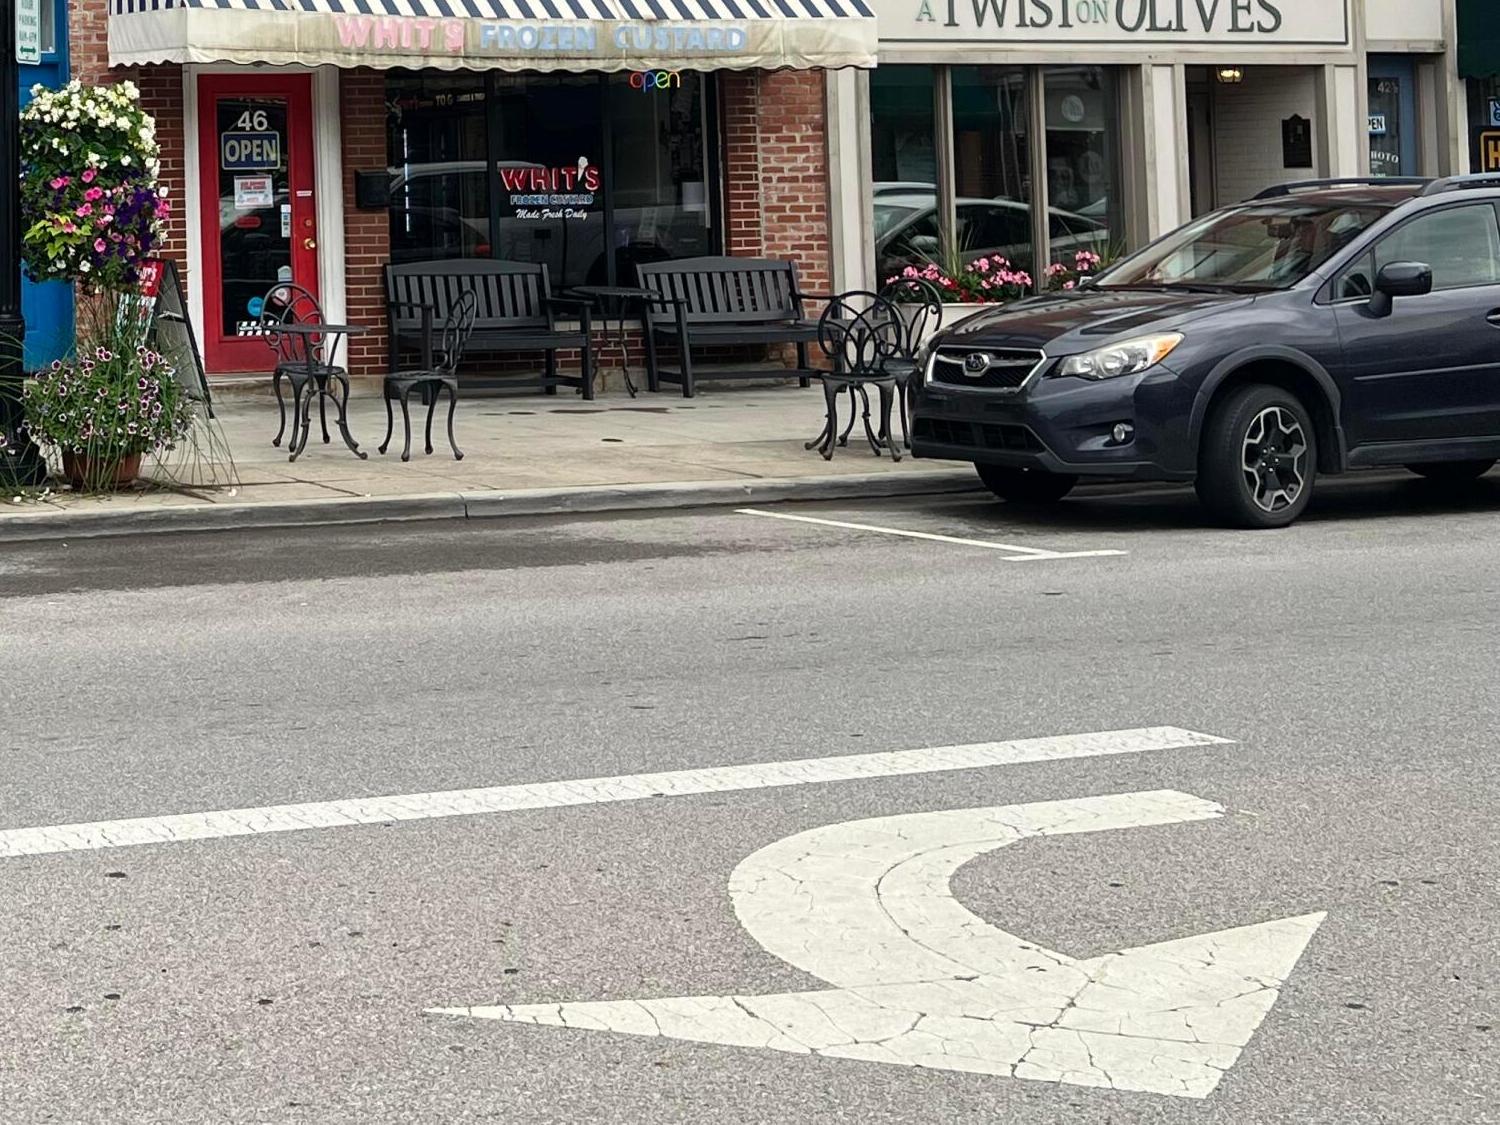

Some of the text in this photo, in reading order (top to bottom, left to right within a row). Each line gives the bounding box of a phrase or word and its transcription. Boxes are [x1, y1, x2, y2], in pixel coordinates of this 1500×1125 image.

[480, 24, 596, 51] FROZEN
[612, 24, 747, 52] CUSTARD
[629, 71, 680, 93] open
[237, 110, 268, 131] 46
[1368, 117, 1383, 130] EN
[225, 139, 277, 162] OPEN
[500, 156, 600, 191] WHIT'S
[510, 194, 549, 206] FROZEN
[516, 208, 588, 220] Made Fresh Daily
